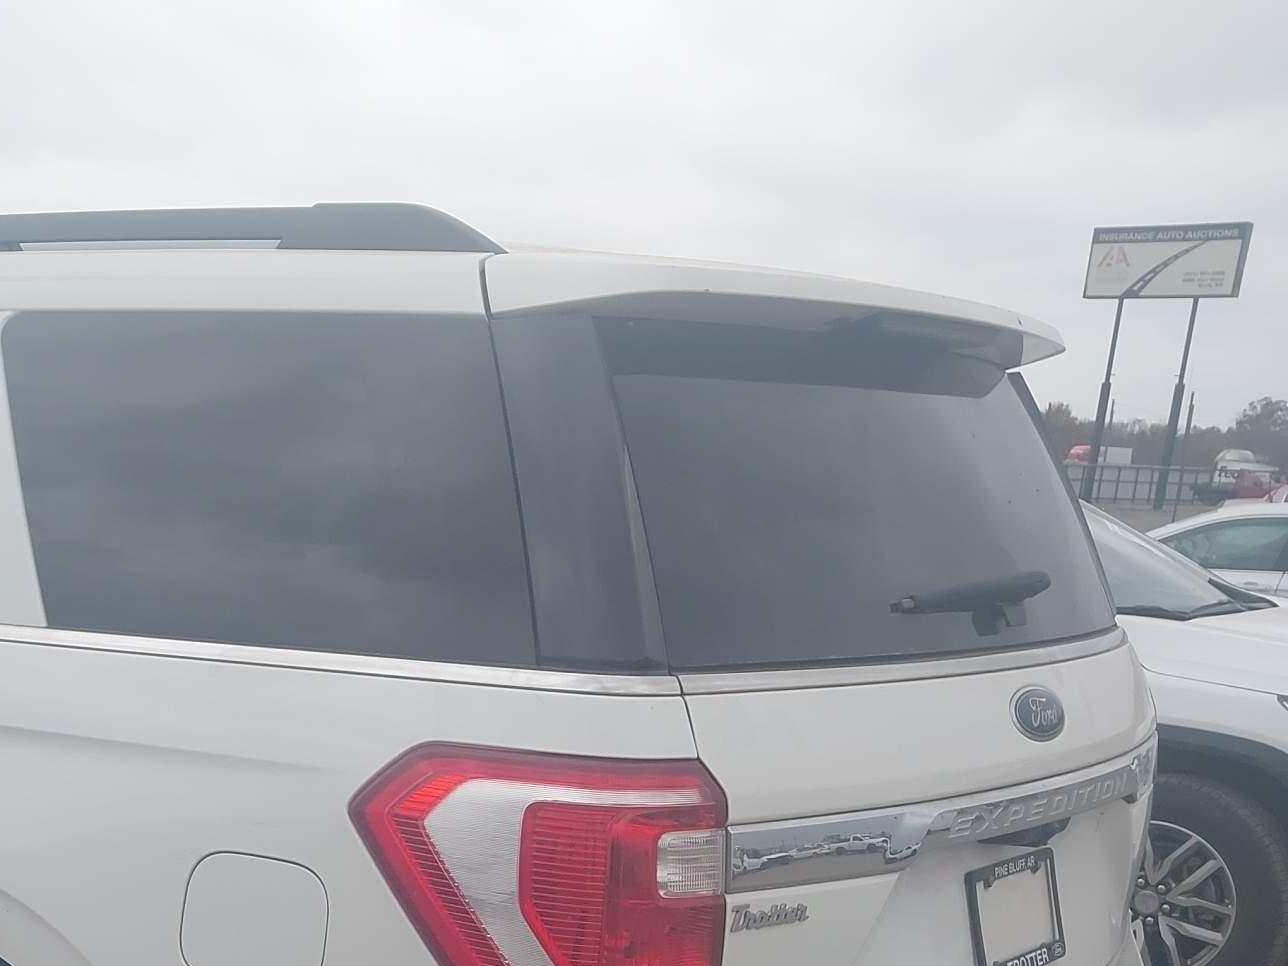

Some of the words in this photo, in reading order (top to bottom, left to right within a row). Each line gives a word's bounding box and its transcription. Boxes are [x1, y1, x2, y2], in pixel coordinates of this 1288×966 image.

[1156, 230, 1184, 239] AUTO
[1185, 228, 1240, 239] AUCTIONS
[1029, 697, 1058, 727] Ford
[948, 772, 1128, 838] EXPEDITION
[994, 864, 1009, 878] PINE
[730, 903, 810, 932] Trotter
